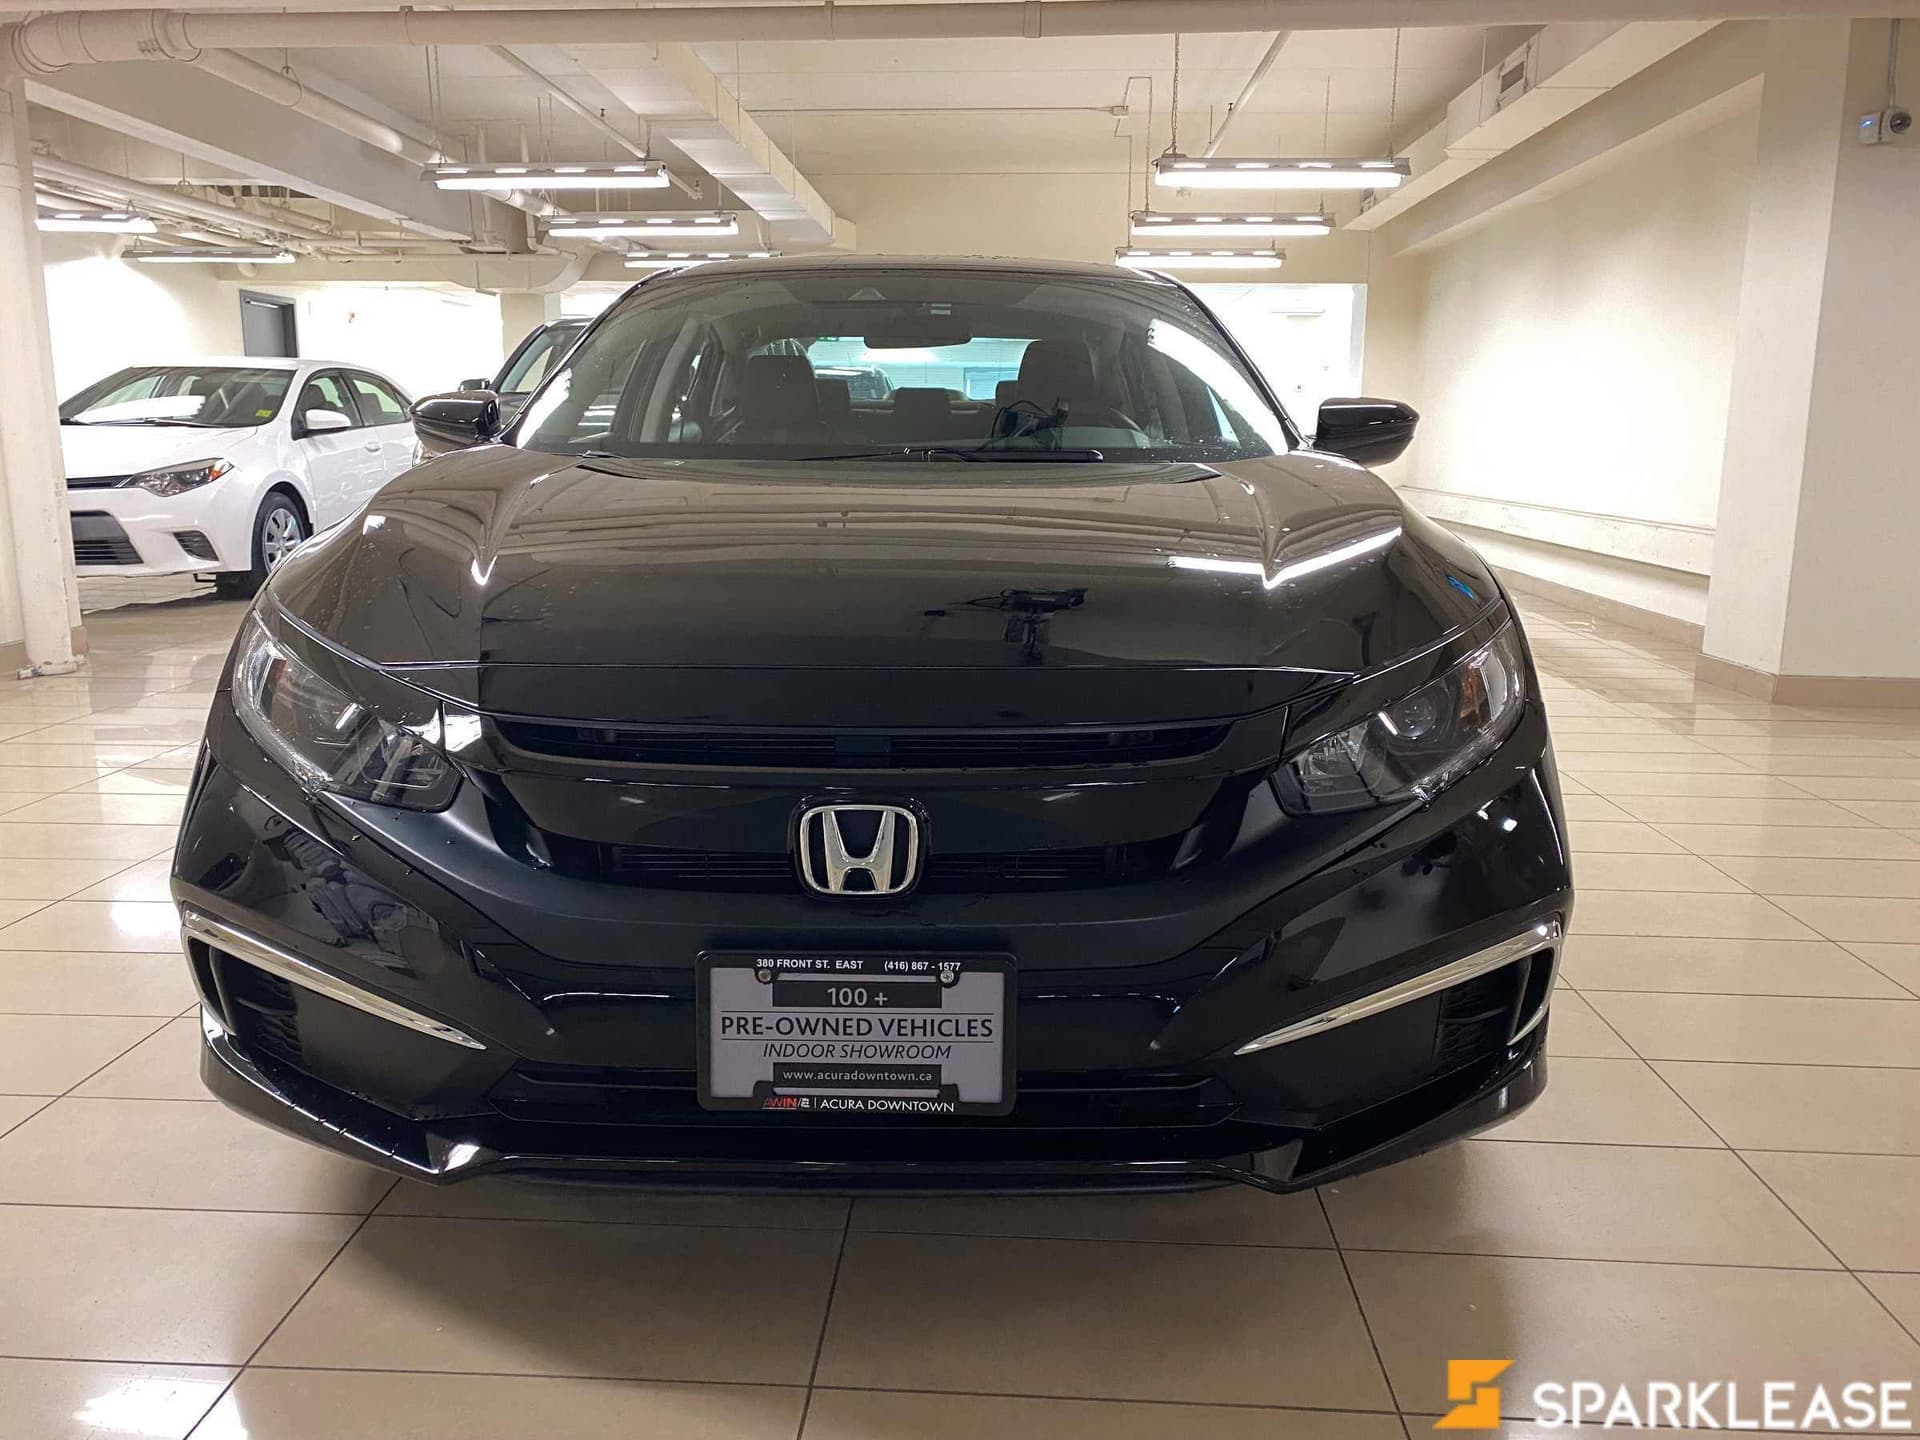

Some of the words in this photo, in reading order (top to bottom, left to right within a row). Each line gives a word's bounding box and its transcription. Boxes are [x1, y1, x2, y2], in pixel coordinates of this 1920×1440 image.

[756, 959, 774, 968] 380
[776, 959, 812, 969] FRONT
[815, 960, 830, 969] ST.
[835, 960, 863, 970] EAST
[884, 961, 909, 971] (416)
[911, 961, 929, 970] 867
[938, 962, 960, 971] 1577
[827, 987, 868, 1006] 100
[721, 1016, 873, 1037] PRE-OWNED
[878, 1017, 993, 1038] VEHICLES
[763, 1043, 836, 1058] INDOOR
[839, 1043, 952, 1059] SHOWROOM
[783, 1069, 932, 1082] www.acuradowntown.ca
[820, 1098, 865, 1110] ACURA
[867, 1100, 954, 1112] DOWNTOWN
